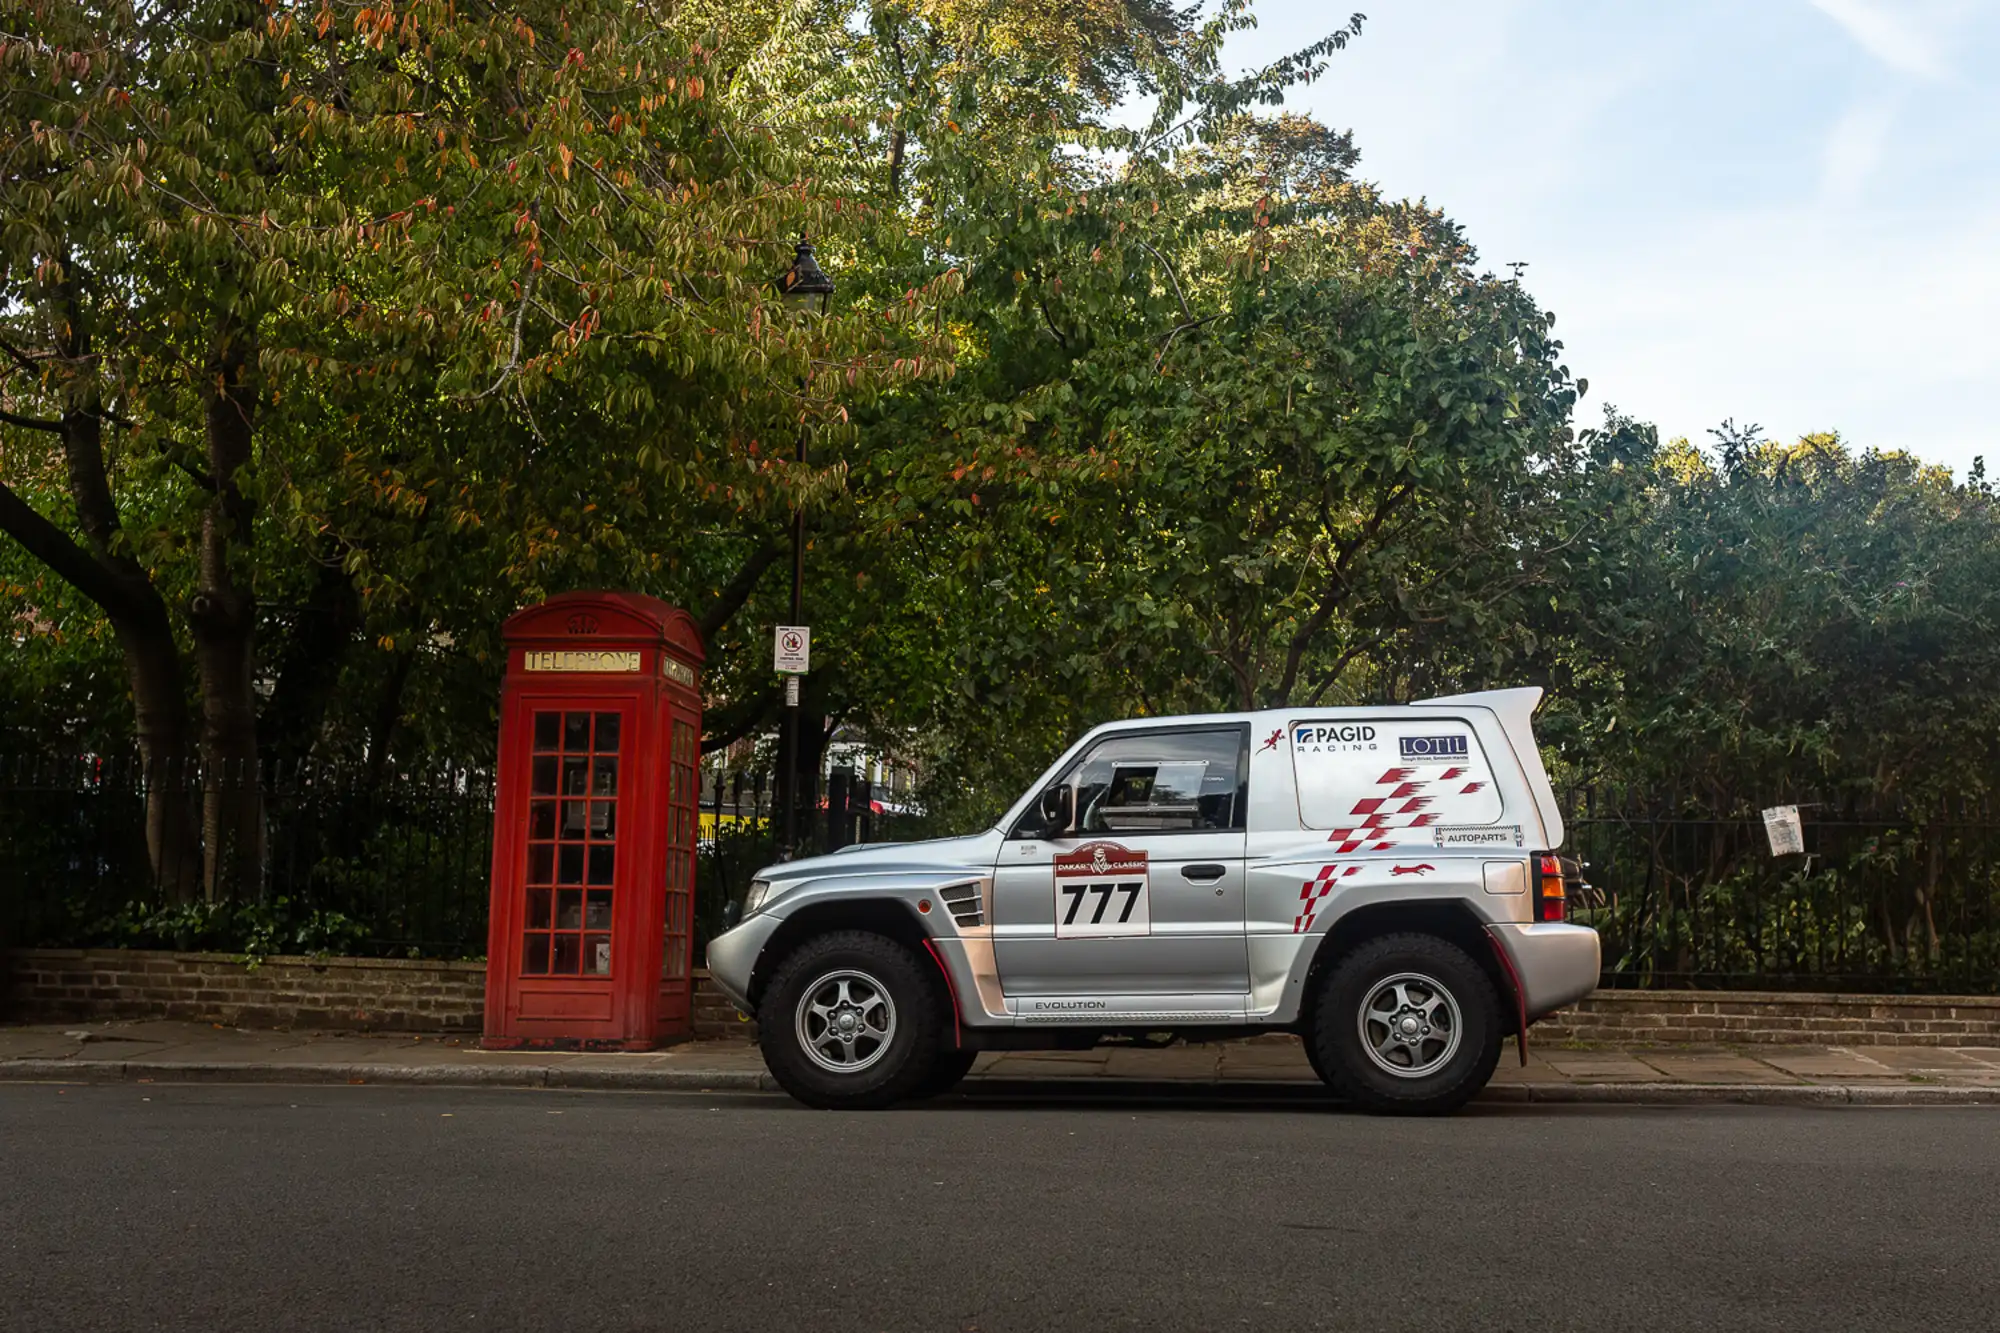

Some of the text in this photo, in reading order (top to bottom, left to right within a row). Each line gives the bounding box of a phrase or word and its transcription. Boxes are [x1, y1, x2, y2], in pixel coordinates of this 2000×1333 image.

[1316, 726, 1376, 743] PAGID
[1297, 743, 1378, 753] RACING
[1401, 737, 1466, 754] LOTIL
[1447, 833, 1507, 842] AUTOPARTS
[1058, 861, 1146, 871] DAKAR CLASSIC
[1062, 882, 1144, 925] 777
[1035, 1001, 1106, 1010] EVOLUTION
